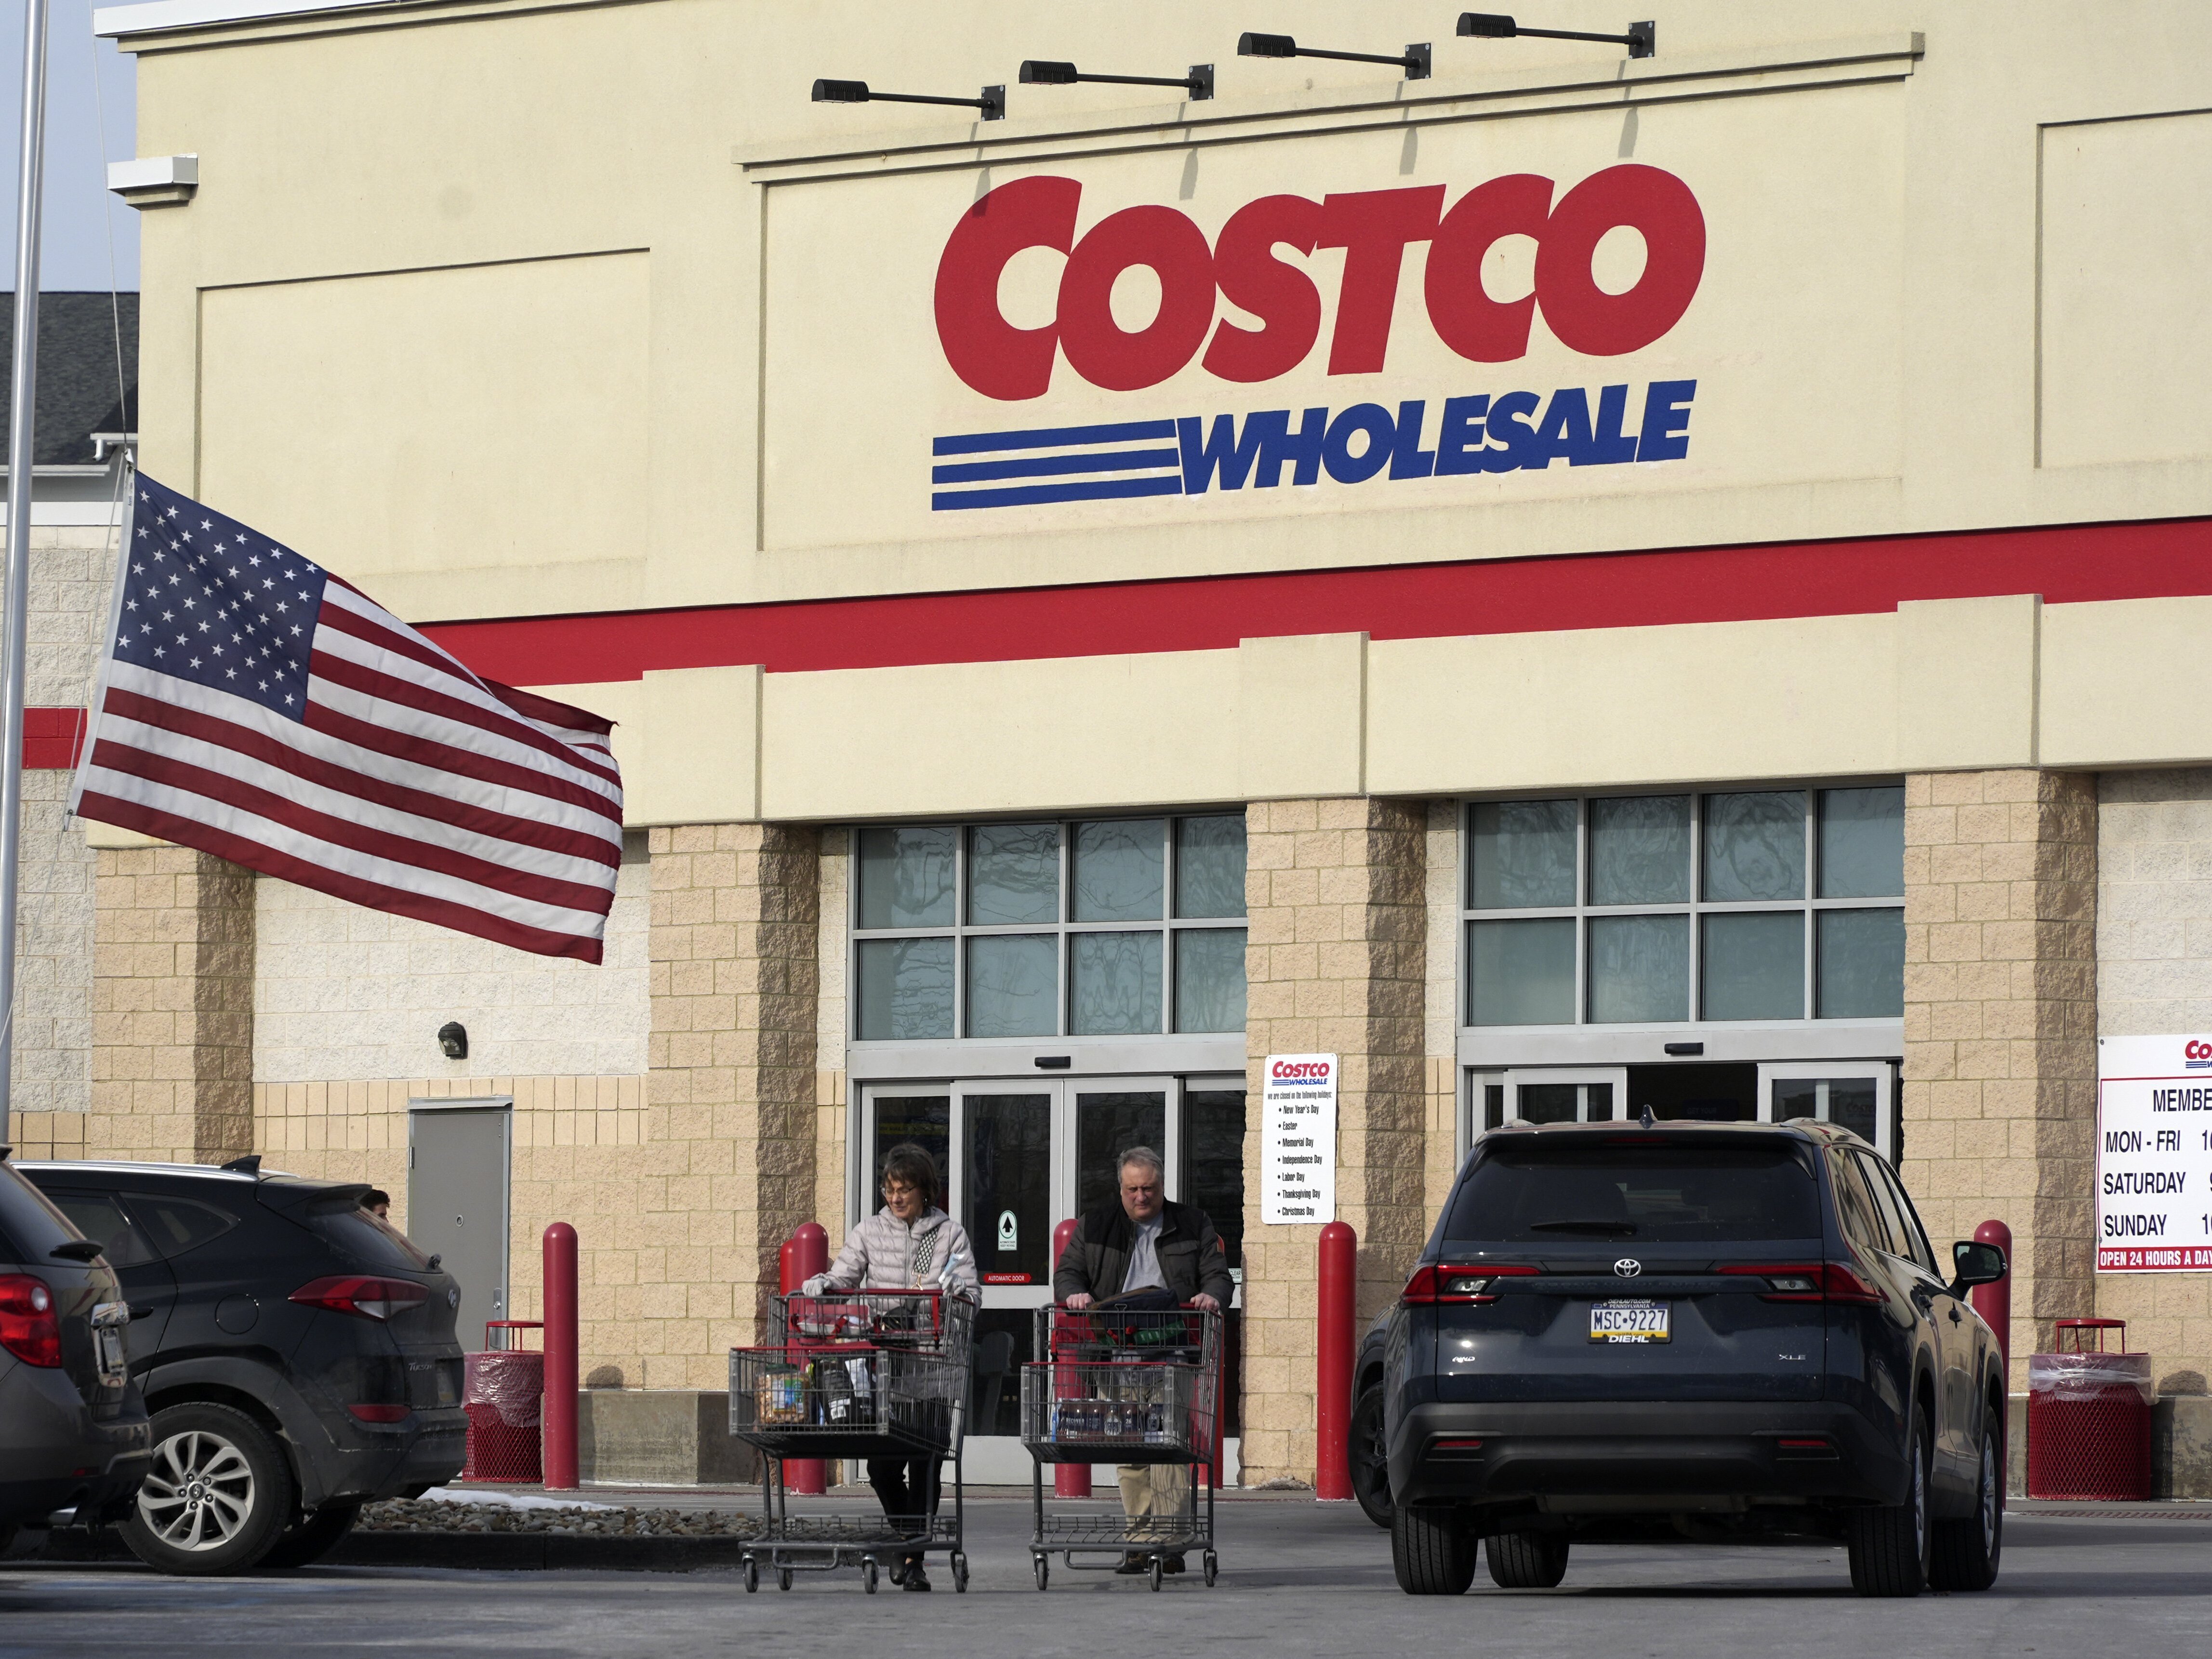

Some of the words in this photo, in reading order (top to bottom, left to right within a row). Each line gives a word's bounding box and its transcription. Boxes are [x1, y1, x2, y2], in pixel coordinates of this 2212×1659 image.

[934, 163, 1706, 400] COSTCO
[1176, 380, 1697, 495] WHOLESALE
[1272, 1061, 1329, 1077] COSTCO
[1302, 1091, 1316, 1100] following
[1284, 1105, 1293, 1114] New
[1295, 1105, 1310, 1114] Year's
[1283, 1121, 1297, 1130] Easter
[1283, 1138, 1304, 1147] Memorial
[2106, 1131, 2142, 1153] MON
[2157, 1130, 2180, 1151] FRI
[2202, 1129, 2212, 1151] 1
[1282, 1155, 1312, 1166] Independence
[1314, 1154, 1322, 1165] Day
[1282, 1172, 1295, 1181] Labor
[1297, 1172, 1305, 1182] Day
[2104, 1172, 2186, 1195] SATURDAY
[1282, 1189, 1311, 1200] Thanksgiving
[1312, 1189, 1321, 1199] Day
[1282, 1207, 1305, 1216] Christmas
[1306, 1207, 1314, 1217] Day
[2105, 1214, 2167, 1236] SUNDAY
[2202, 1213, 2212, 1234] 1
[2100, 1251, 2127, 1266] OPEN
[2130, 1251, 2143, 1266] 24
[2146, 1250, 2181, 1266] HOURS
[2184, 1250, 2191, 1265] A
